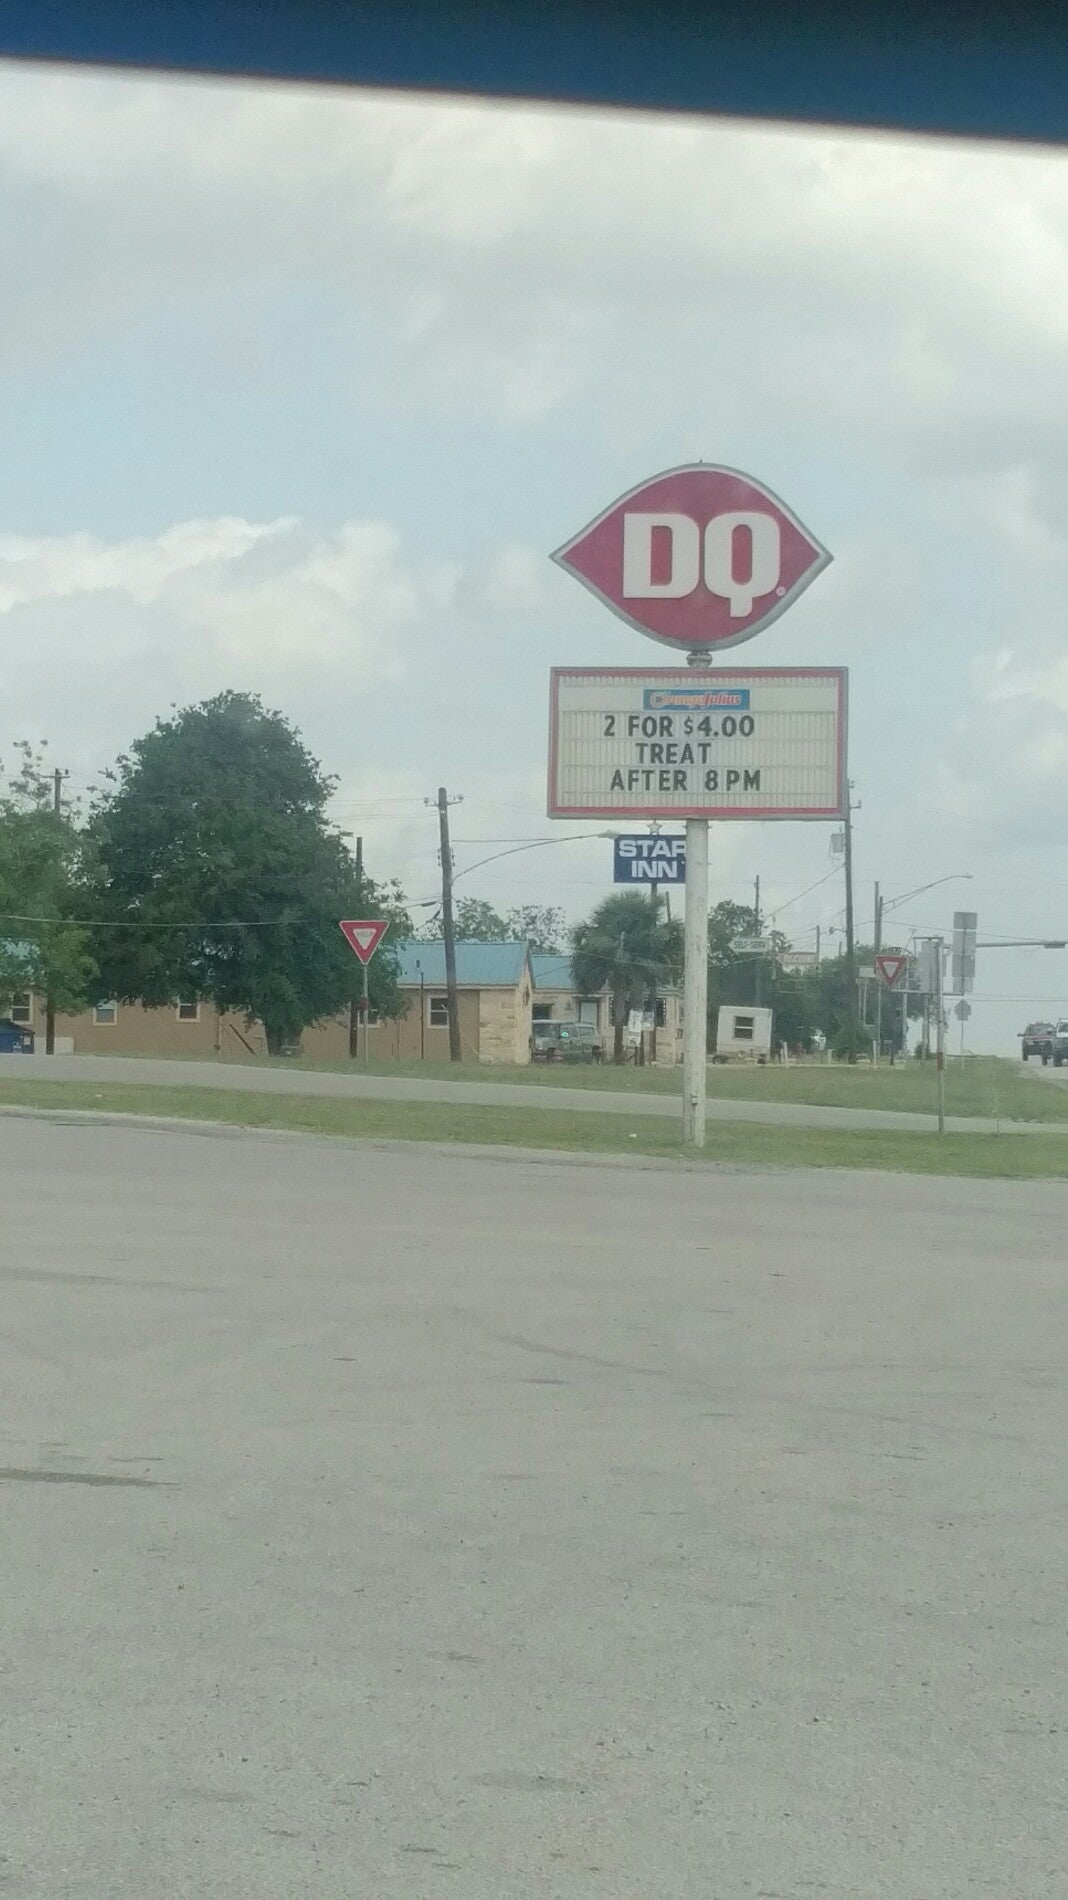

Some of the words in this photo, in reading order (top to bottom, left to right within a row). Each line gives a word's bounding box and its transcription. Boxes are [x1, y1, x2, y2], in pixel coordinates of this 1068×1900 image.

[623, 512, 781, 617] DQ
[603, 715, 616, 737] 2
[628, 716, 673, 737] FOR
[683, 715, 755, 737] $4.00
[636, 743, 712, 765] TREAT
[610, 770, 688, 791] AFTER
[632, 861, 677, 878] INN
